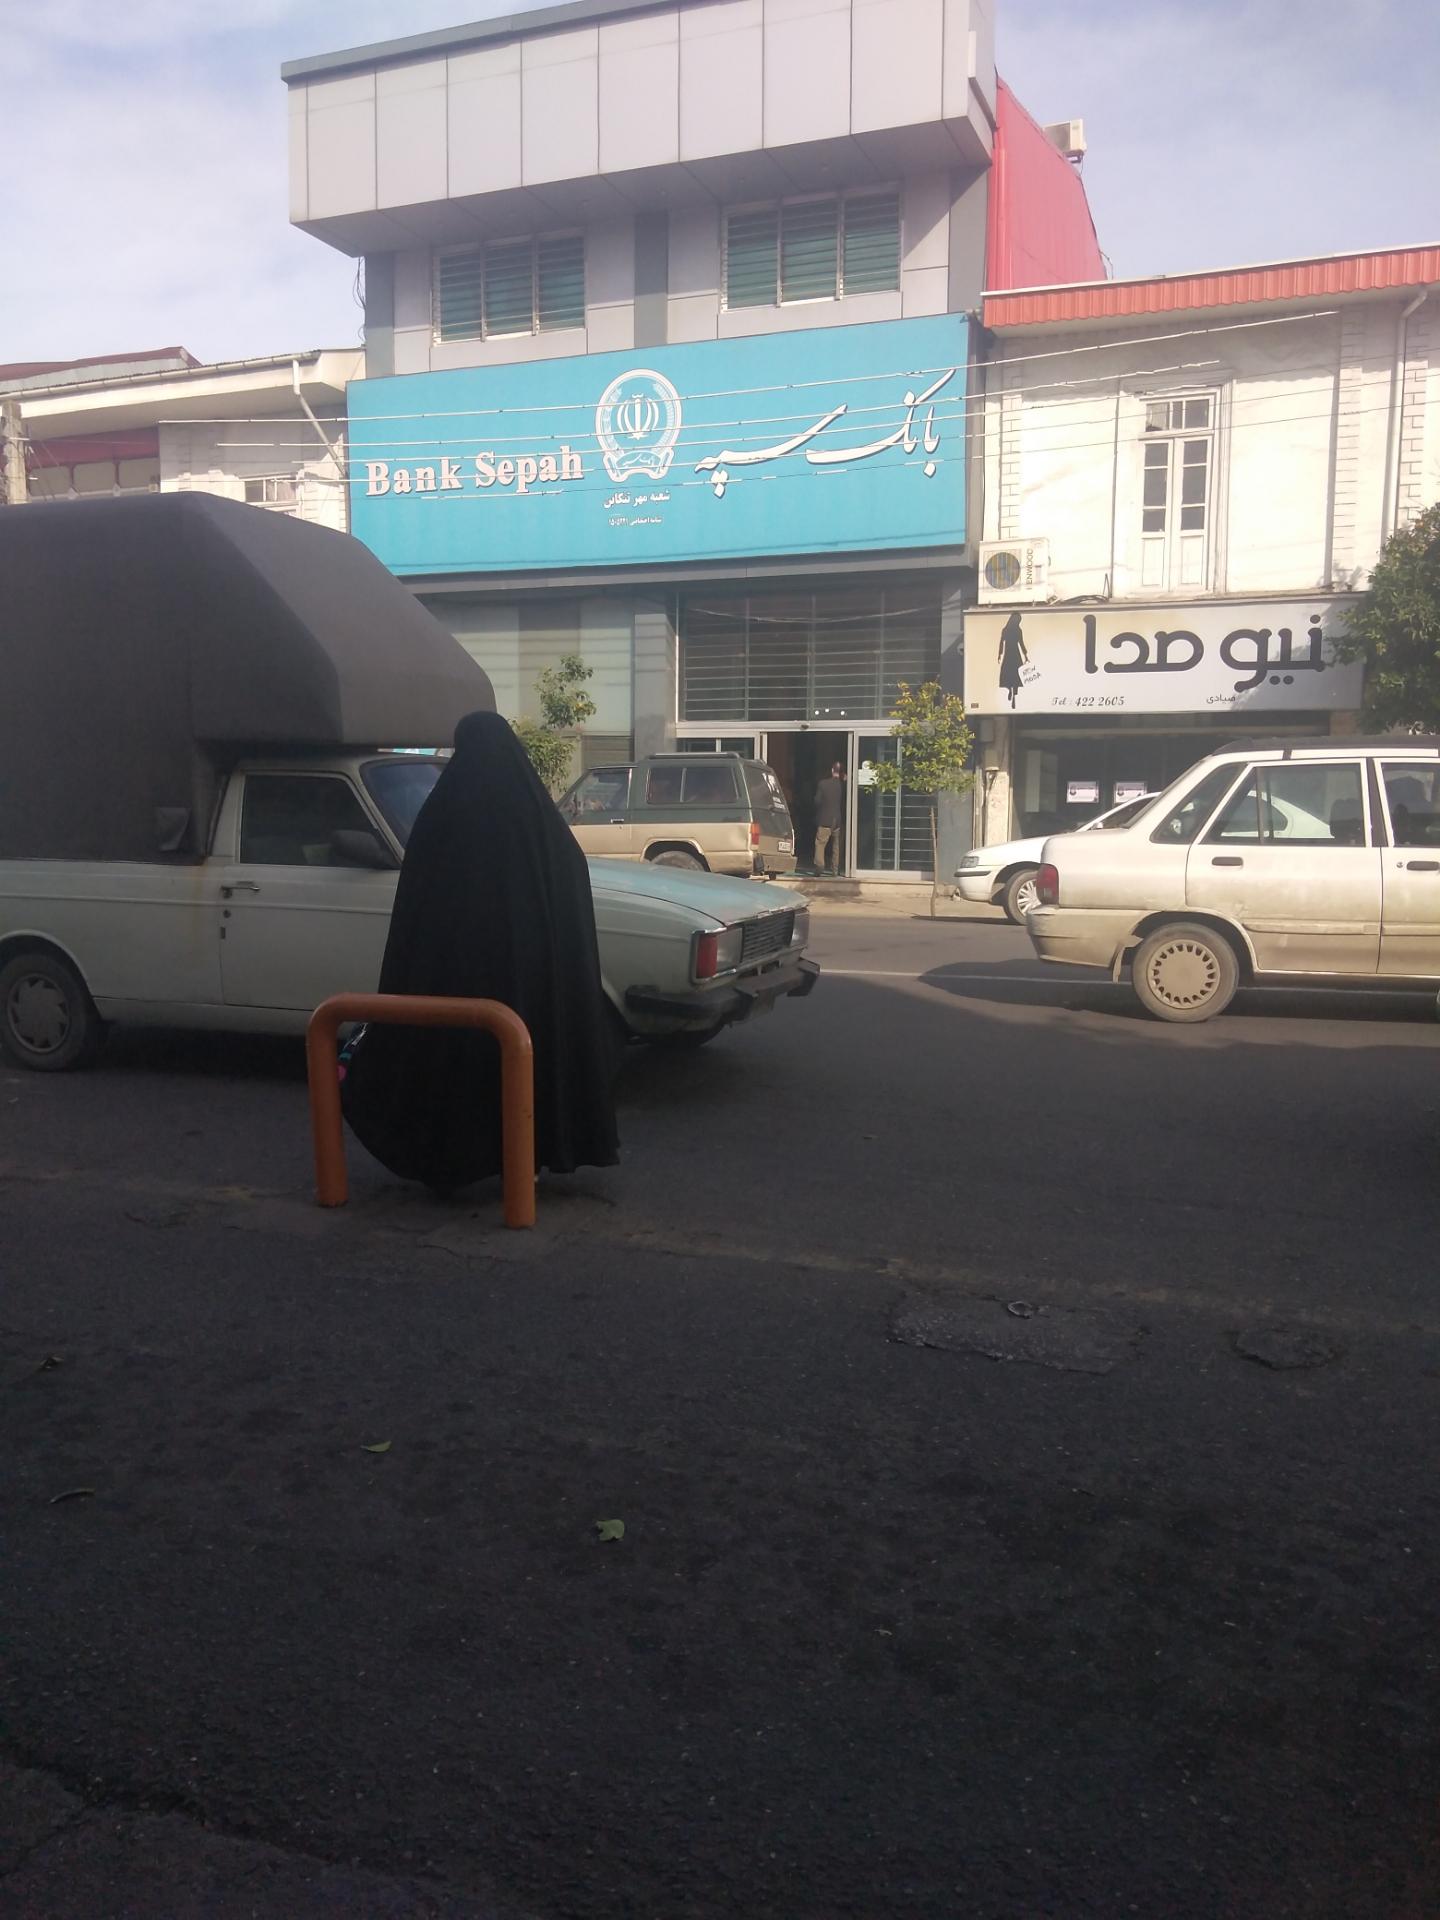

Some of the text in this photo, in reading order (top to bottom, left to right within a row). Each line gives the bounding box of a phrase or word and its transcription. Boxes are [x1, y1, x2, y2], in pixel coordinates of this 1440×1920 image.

[695, 369, 956, 498] بانک سپه
[365, 446, 585, 497] Bank Sepah
[1075, 696, 1095, 707] 422
[1098, 696, 1125, 706] 2605
